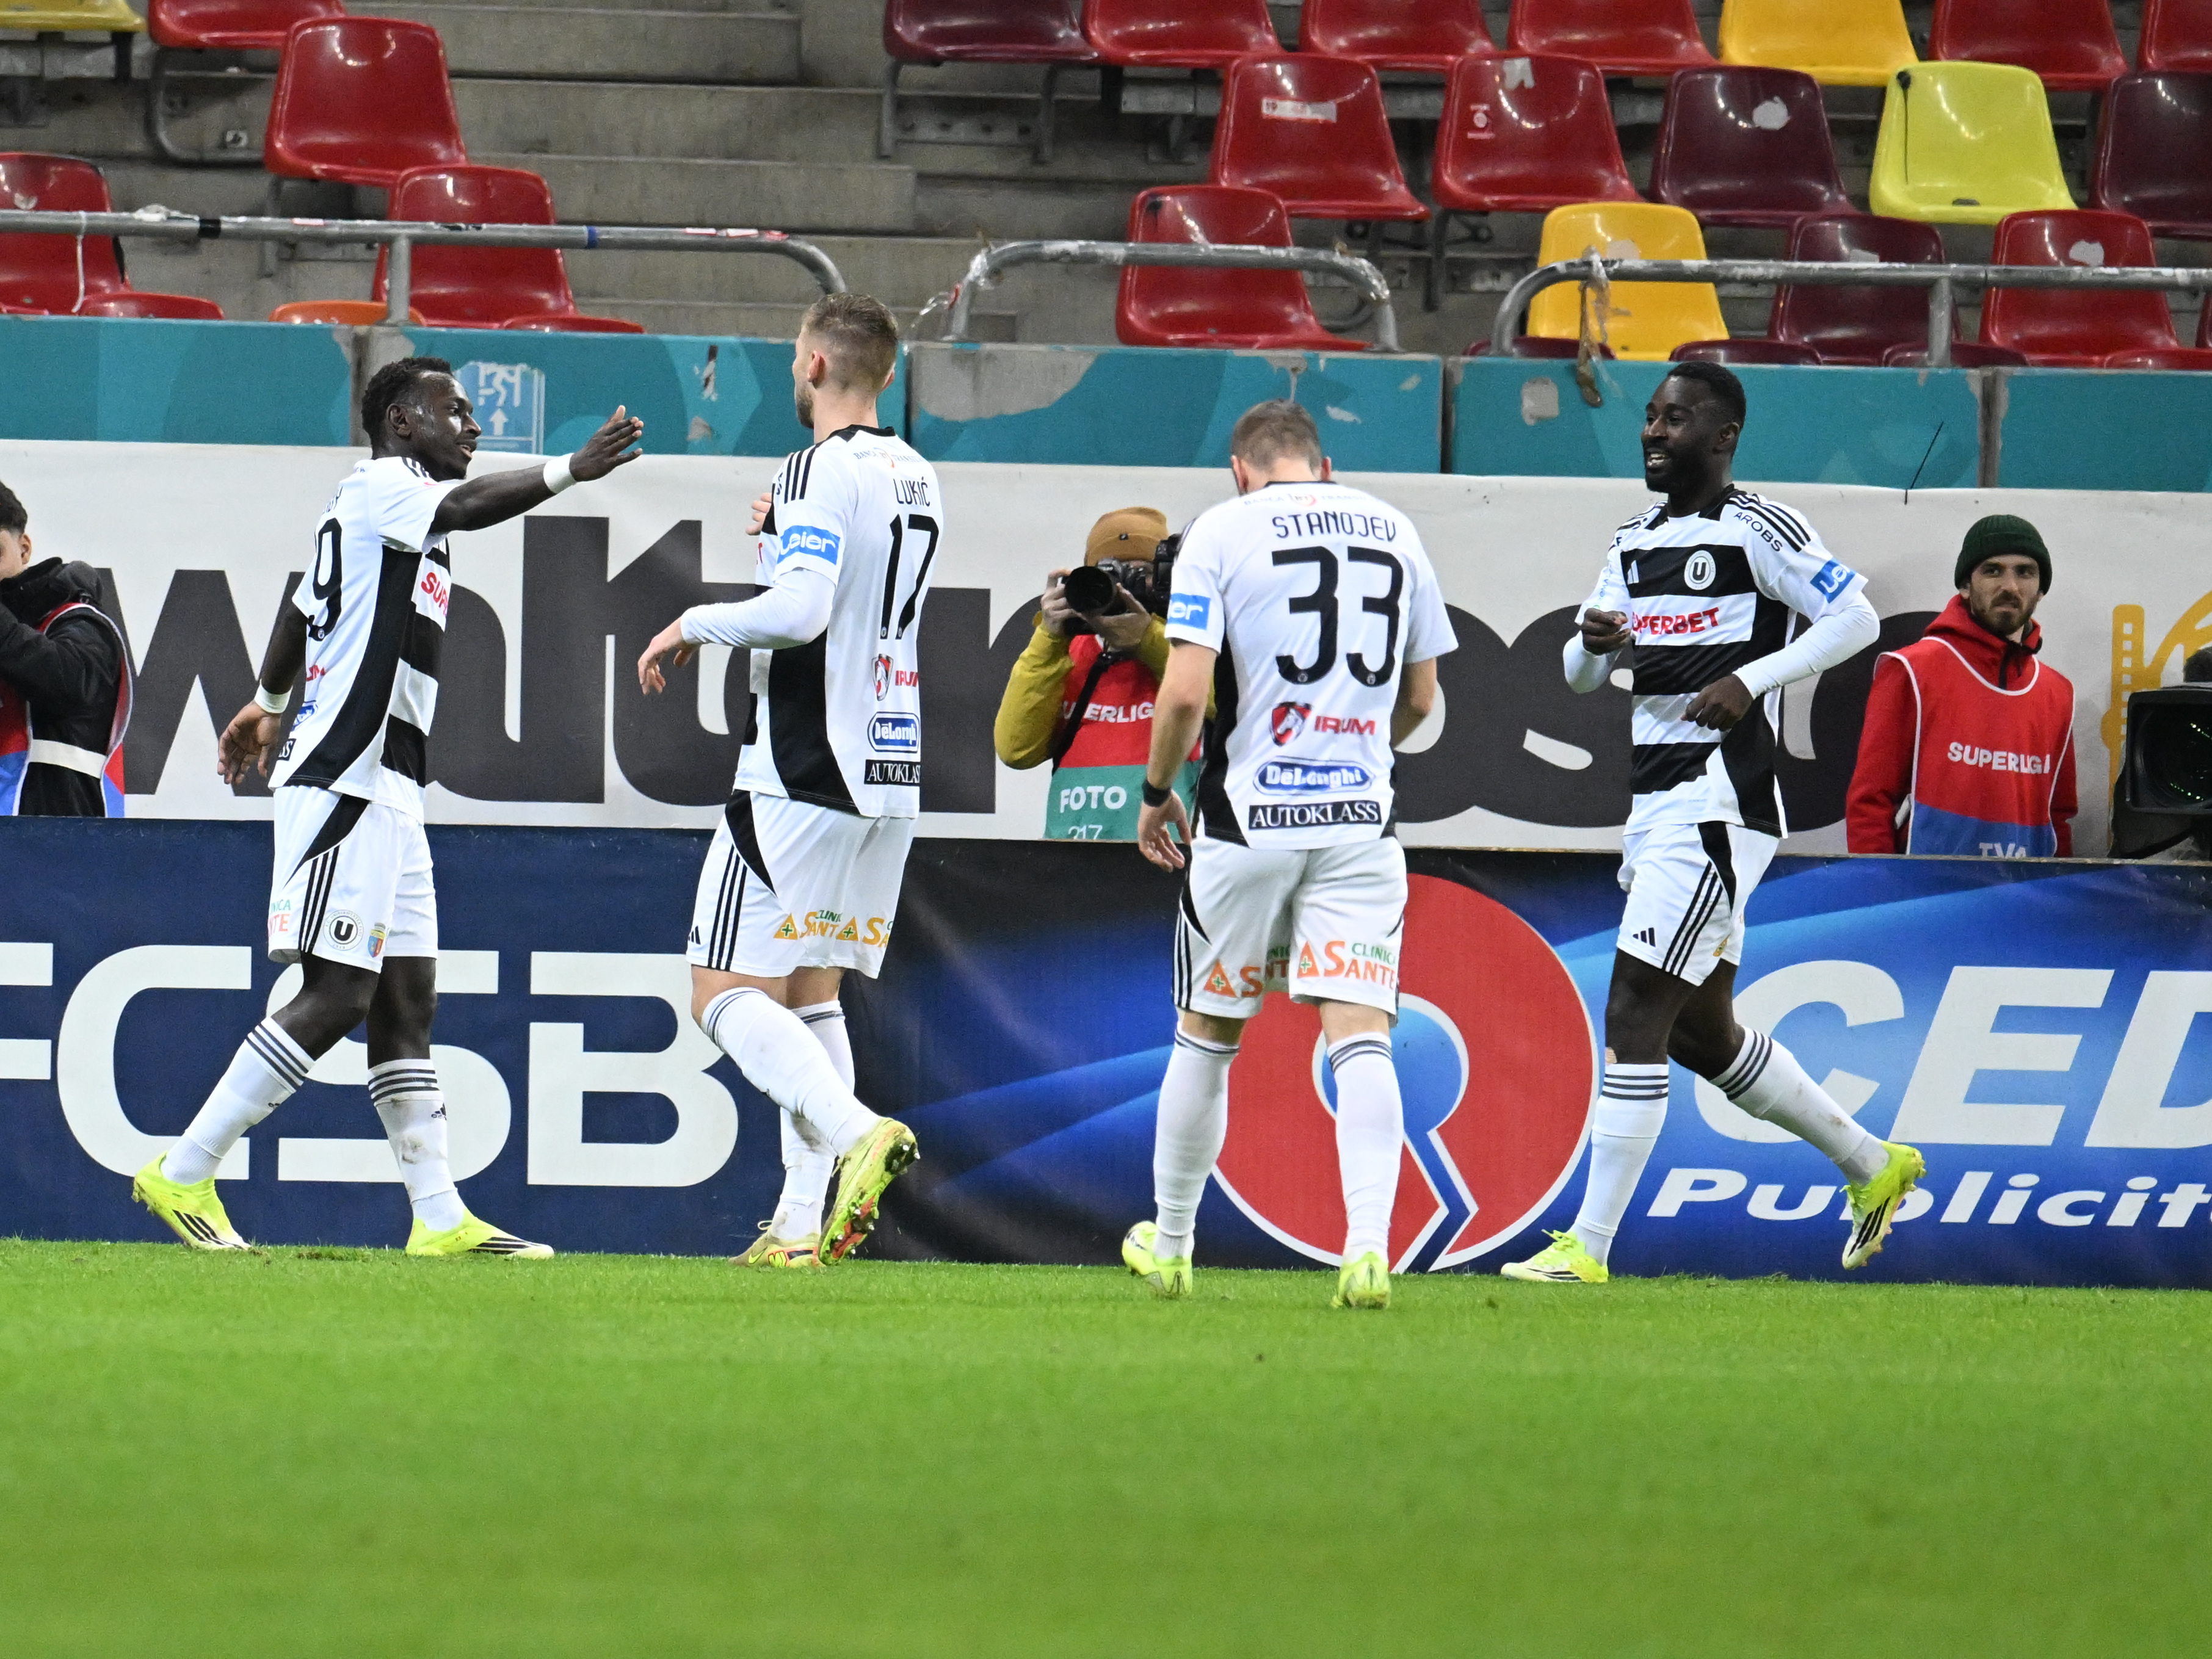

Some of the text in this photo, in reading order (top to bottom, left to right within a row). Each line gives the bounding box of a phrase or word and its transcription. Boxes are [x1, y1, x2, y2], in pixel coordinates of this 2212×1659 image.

[893, 476, 930, 507] LUKIĆ
[1272, 510, 1396, 542] STANOJEV
[1734, 511, 1782, 552] AROBS
[308, 518, 342, 642] 9
[880, 513, 939, 640] 17
[1272, 546, 1403, 687] 33
[1315, 715, 1376, 736] IRUM
[1060, 786, 1127, 814] FOTO
[1252, 801, 1379, 828] AUTOKLASS
[334, 920, 354, 941] U
[800, 912, 840, 938] SANT
[1324, 941, 1395, 990] SANTE
